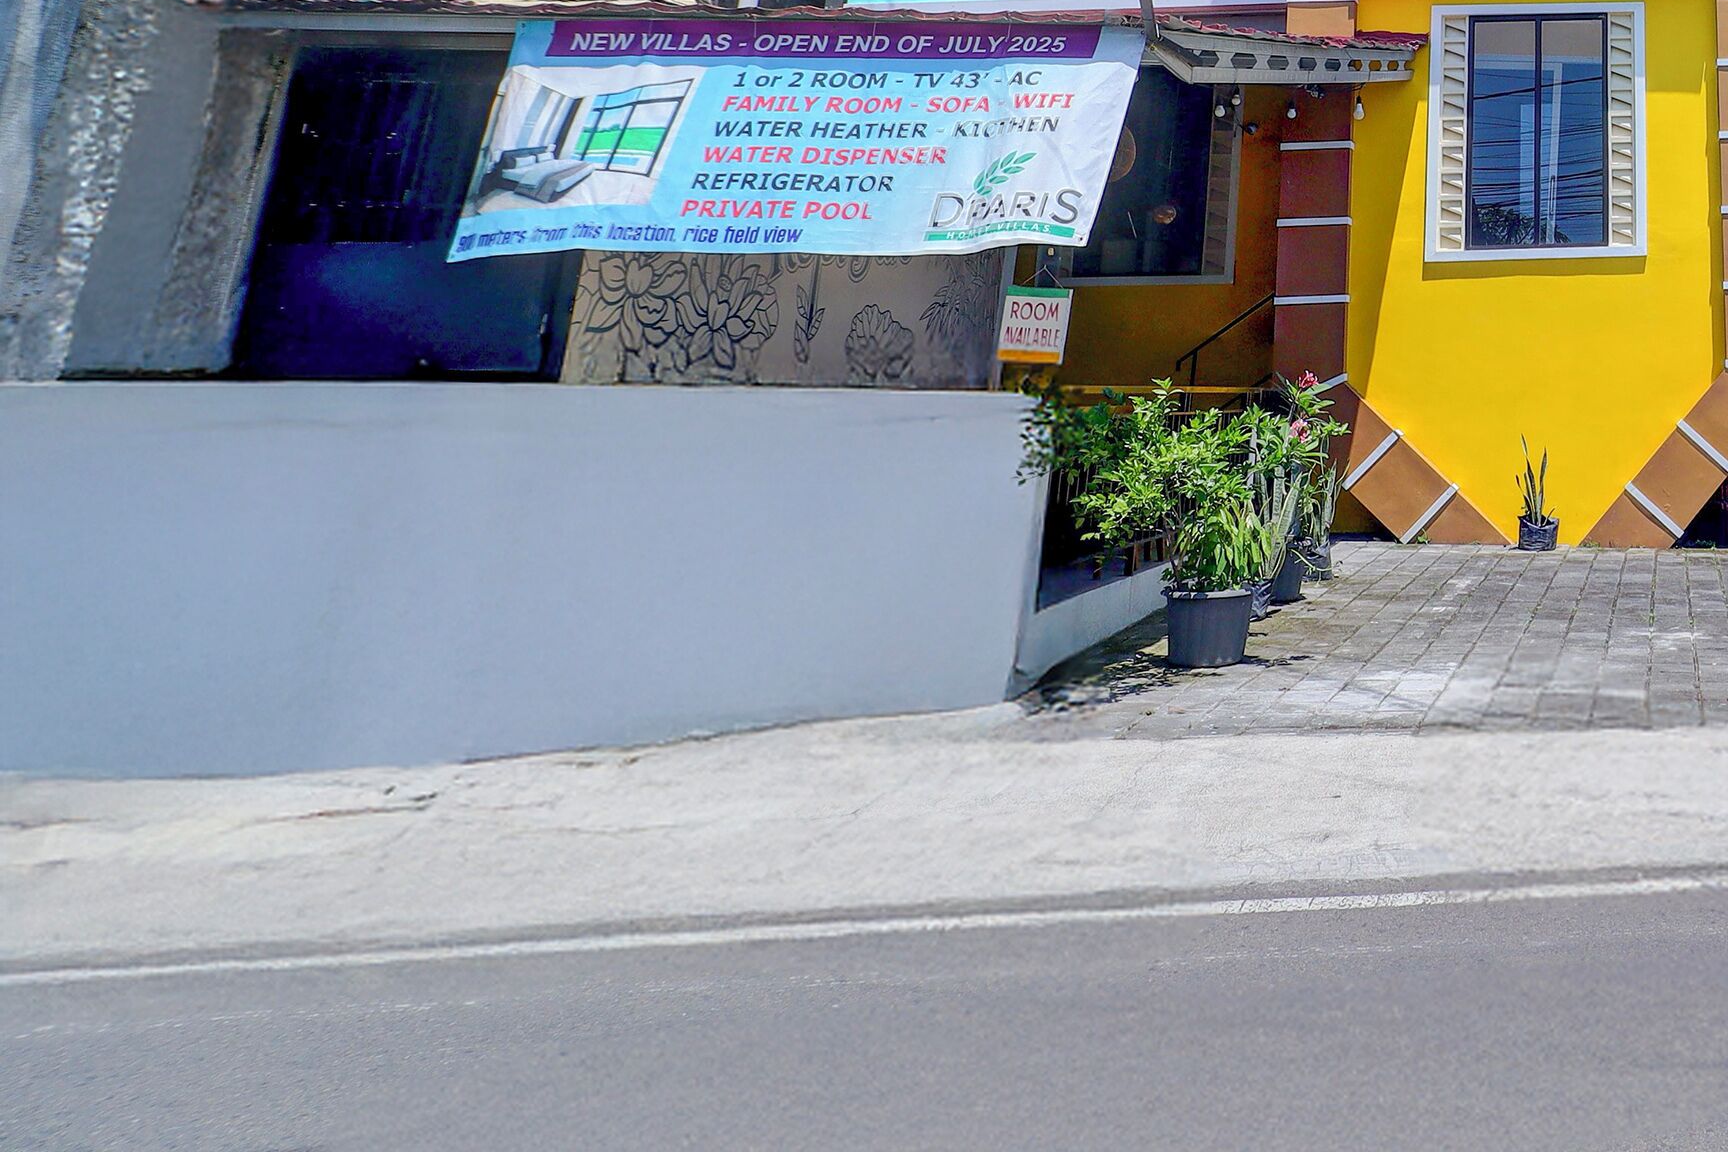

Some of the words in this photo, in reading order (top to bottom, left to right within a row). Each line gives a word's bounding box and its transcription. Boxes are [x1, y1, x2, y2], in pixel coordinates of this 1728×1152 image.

[570, 33, 635, 51] NEW
[641, 33, 732, 51] VILLAS
[753, 34, 829, 52] OPEN
[834, 35, 890, 53] END
[896, 35, 934, 53] OF
[938, 36, 1006, 53] JULY
[1007, 36, 1066, 53] 2025
[733, 72, 747, 87] 1
[755, 75, 783, 87] or
[788, 72, 803, 88] 2
[810, 72, 888, 89] ROOM
[914, 73, 945, 88] TV
[1008, 71, 1043, 86] AC
[721, 95, 820, 112] FAMILY
[824, 96, 902, 113] ROOM
[926, 97, 991, 113] SOFA
[1013, 93, 1074, 109] WIFI
[714, 121, 802, 137] WATER
[810, 122, 928, 140] HEATHER
[703, 146, 794, 164] WATER
[800, 146, 947, 166] DISPENSER
[691, 173, 894, 192] REFRIGERATOR
[679, 200, 797, 219] PRIVATE
[802, 201, 873, 220] POOL
[477, 229, 528, 247] meters
[571, 221, 603, 239] this
[682, 224, 719, 243] rice
[723, 225, 761, 243] field
[764, 226, 803, 243] view
[997, 221, 1051, 234] VILLAS
[1010, 301, 1059, 321] ROOM
[1003, 326, 1060, 347] AVAILABLE
